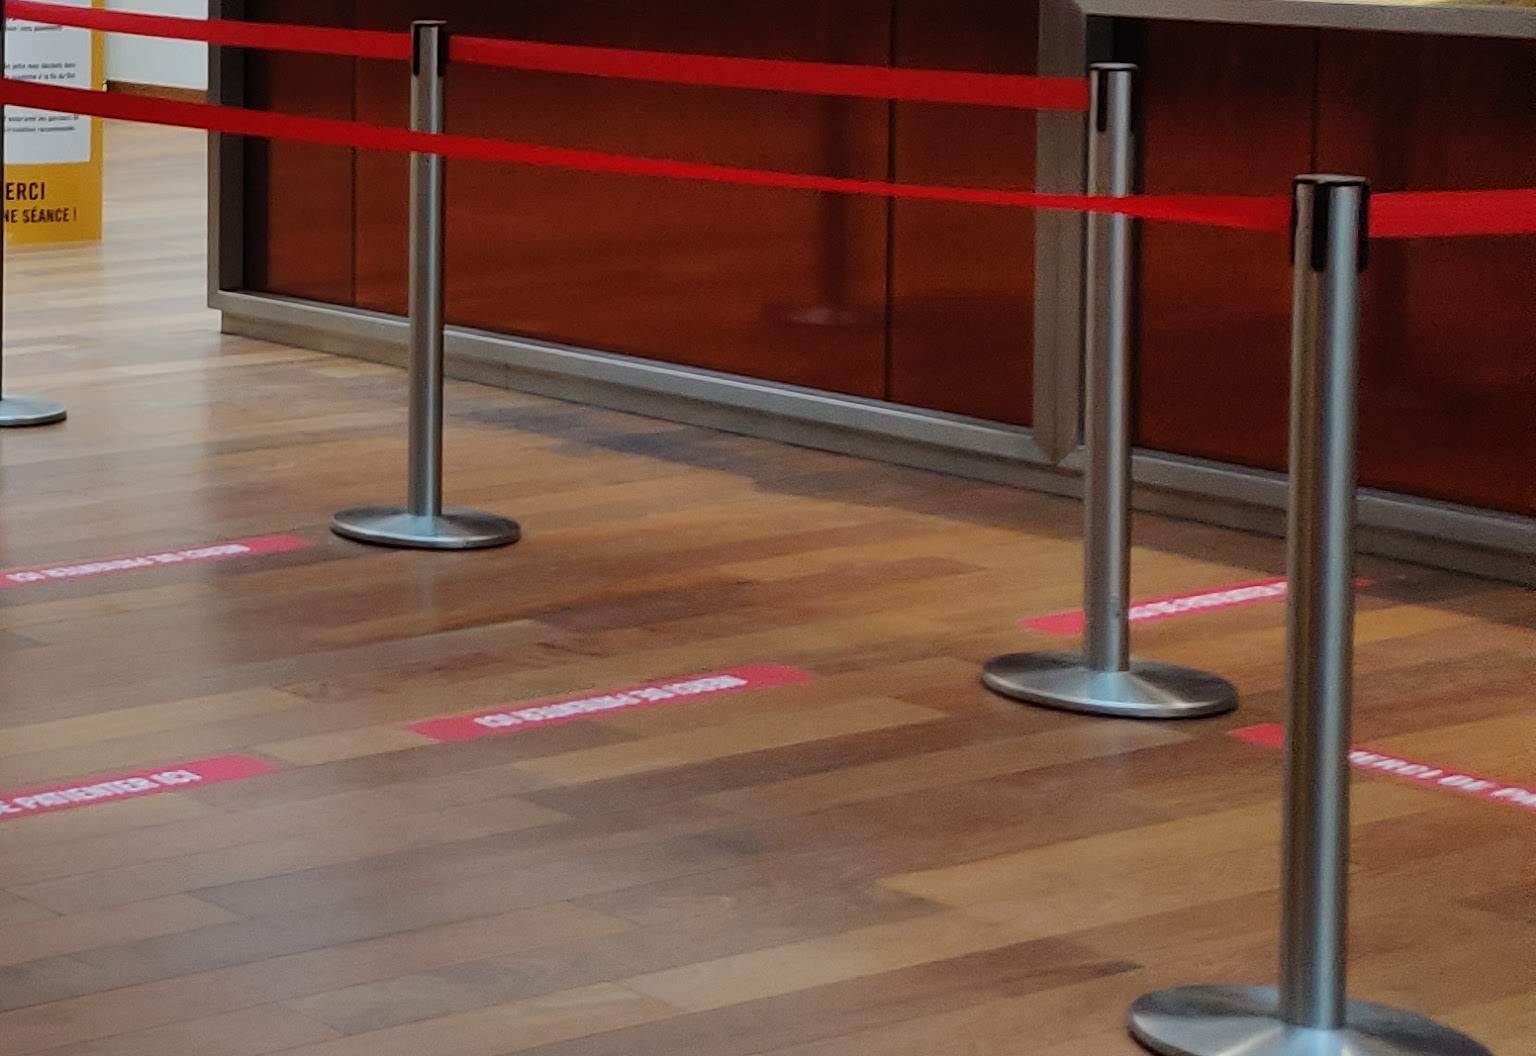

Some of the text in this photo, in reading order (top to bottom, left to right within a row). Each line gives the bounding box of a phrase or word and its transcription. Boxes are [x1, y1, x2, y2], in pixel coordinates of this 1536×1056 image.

[5, 182, 45, 201] ERCI
[22, 204, 70, 224] SÉANCE
[14, 776, 160, 810] PATIENTER
[151, 769, 203, 785] ICI
